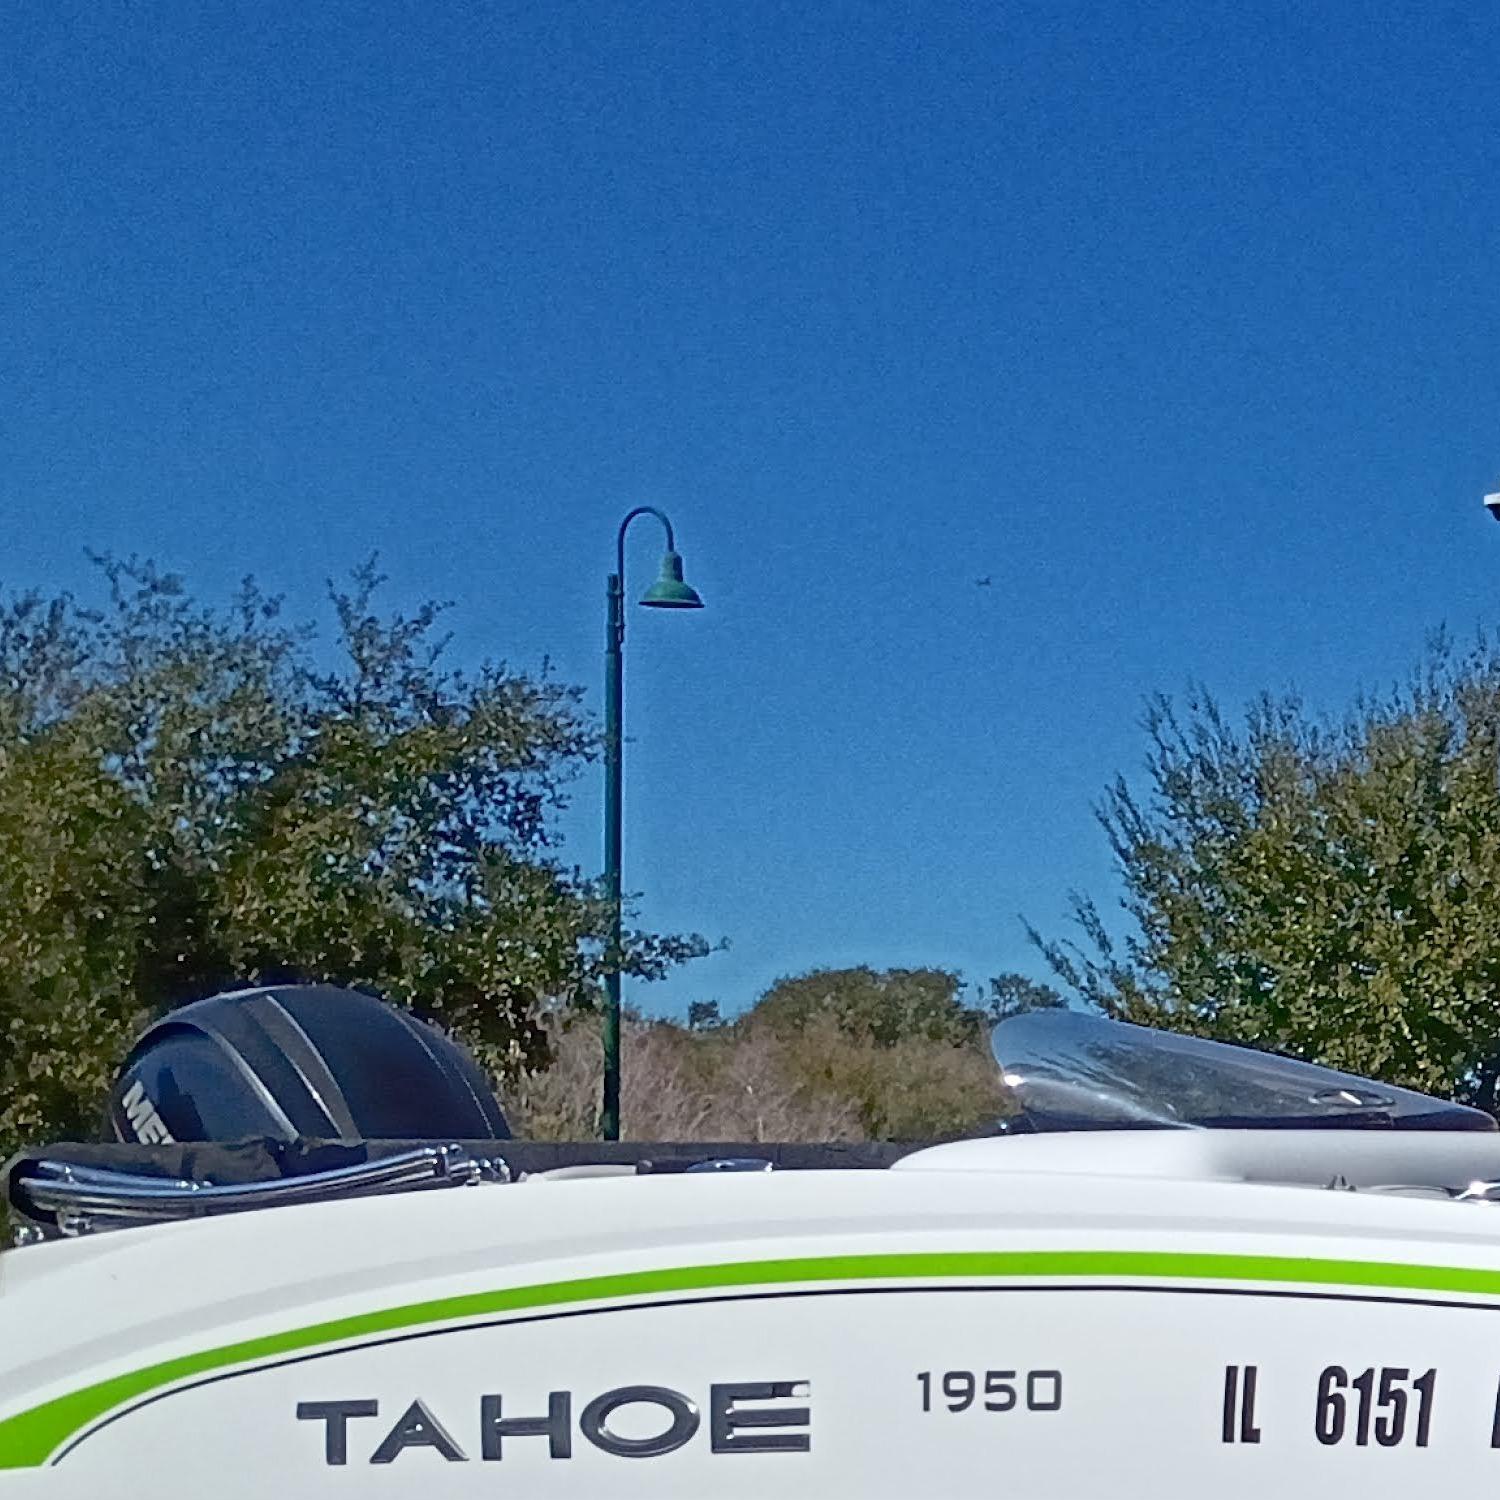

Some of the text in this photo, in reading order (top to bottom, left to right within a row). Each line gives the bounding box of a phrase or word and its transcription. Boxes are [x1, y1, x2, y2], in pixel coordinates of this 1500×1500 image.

[122, 1080, 175, 1145] ME
[297, 1369, 1063, 1464] TAHOE 1950
[1222, 1365, 1261, 1444] IL
[1315, 1365, 1437, 1448] 6151
